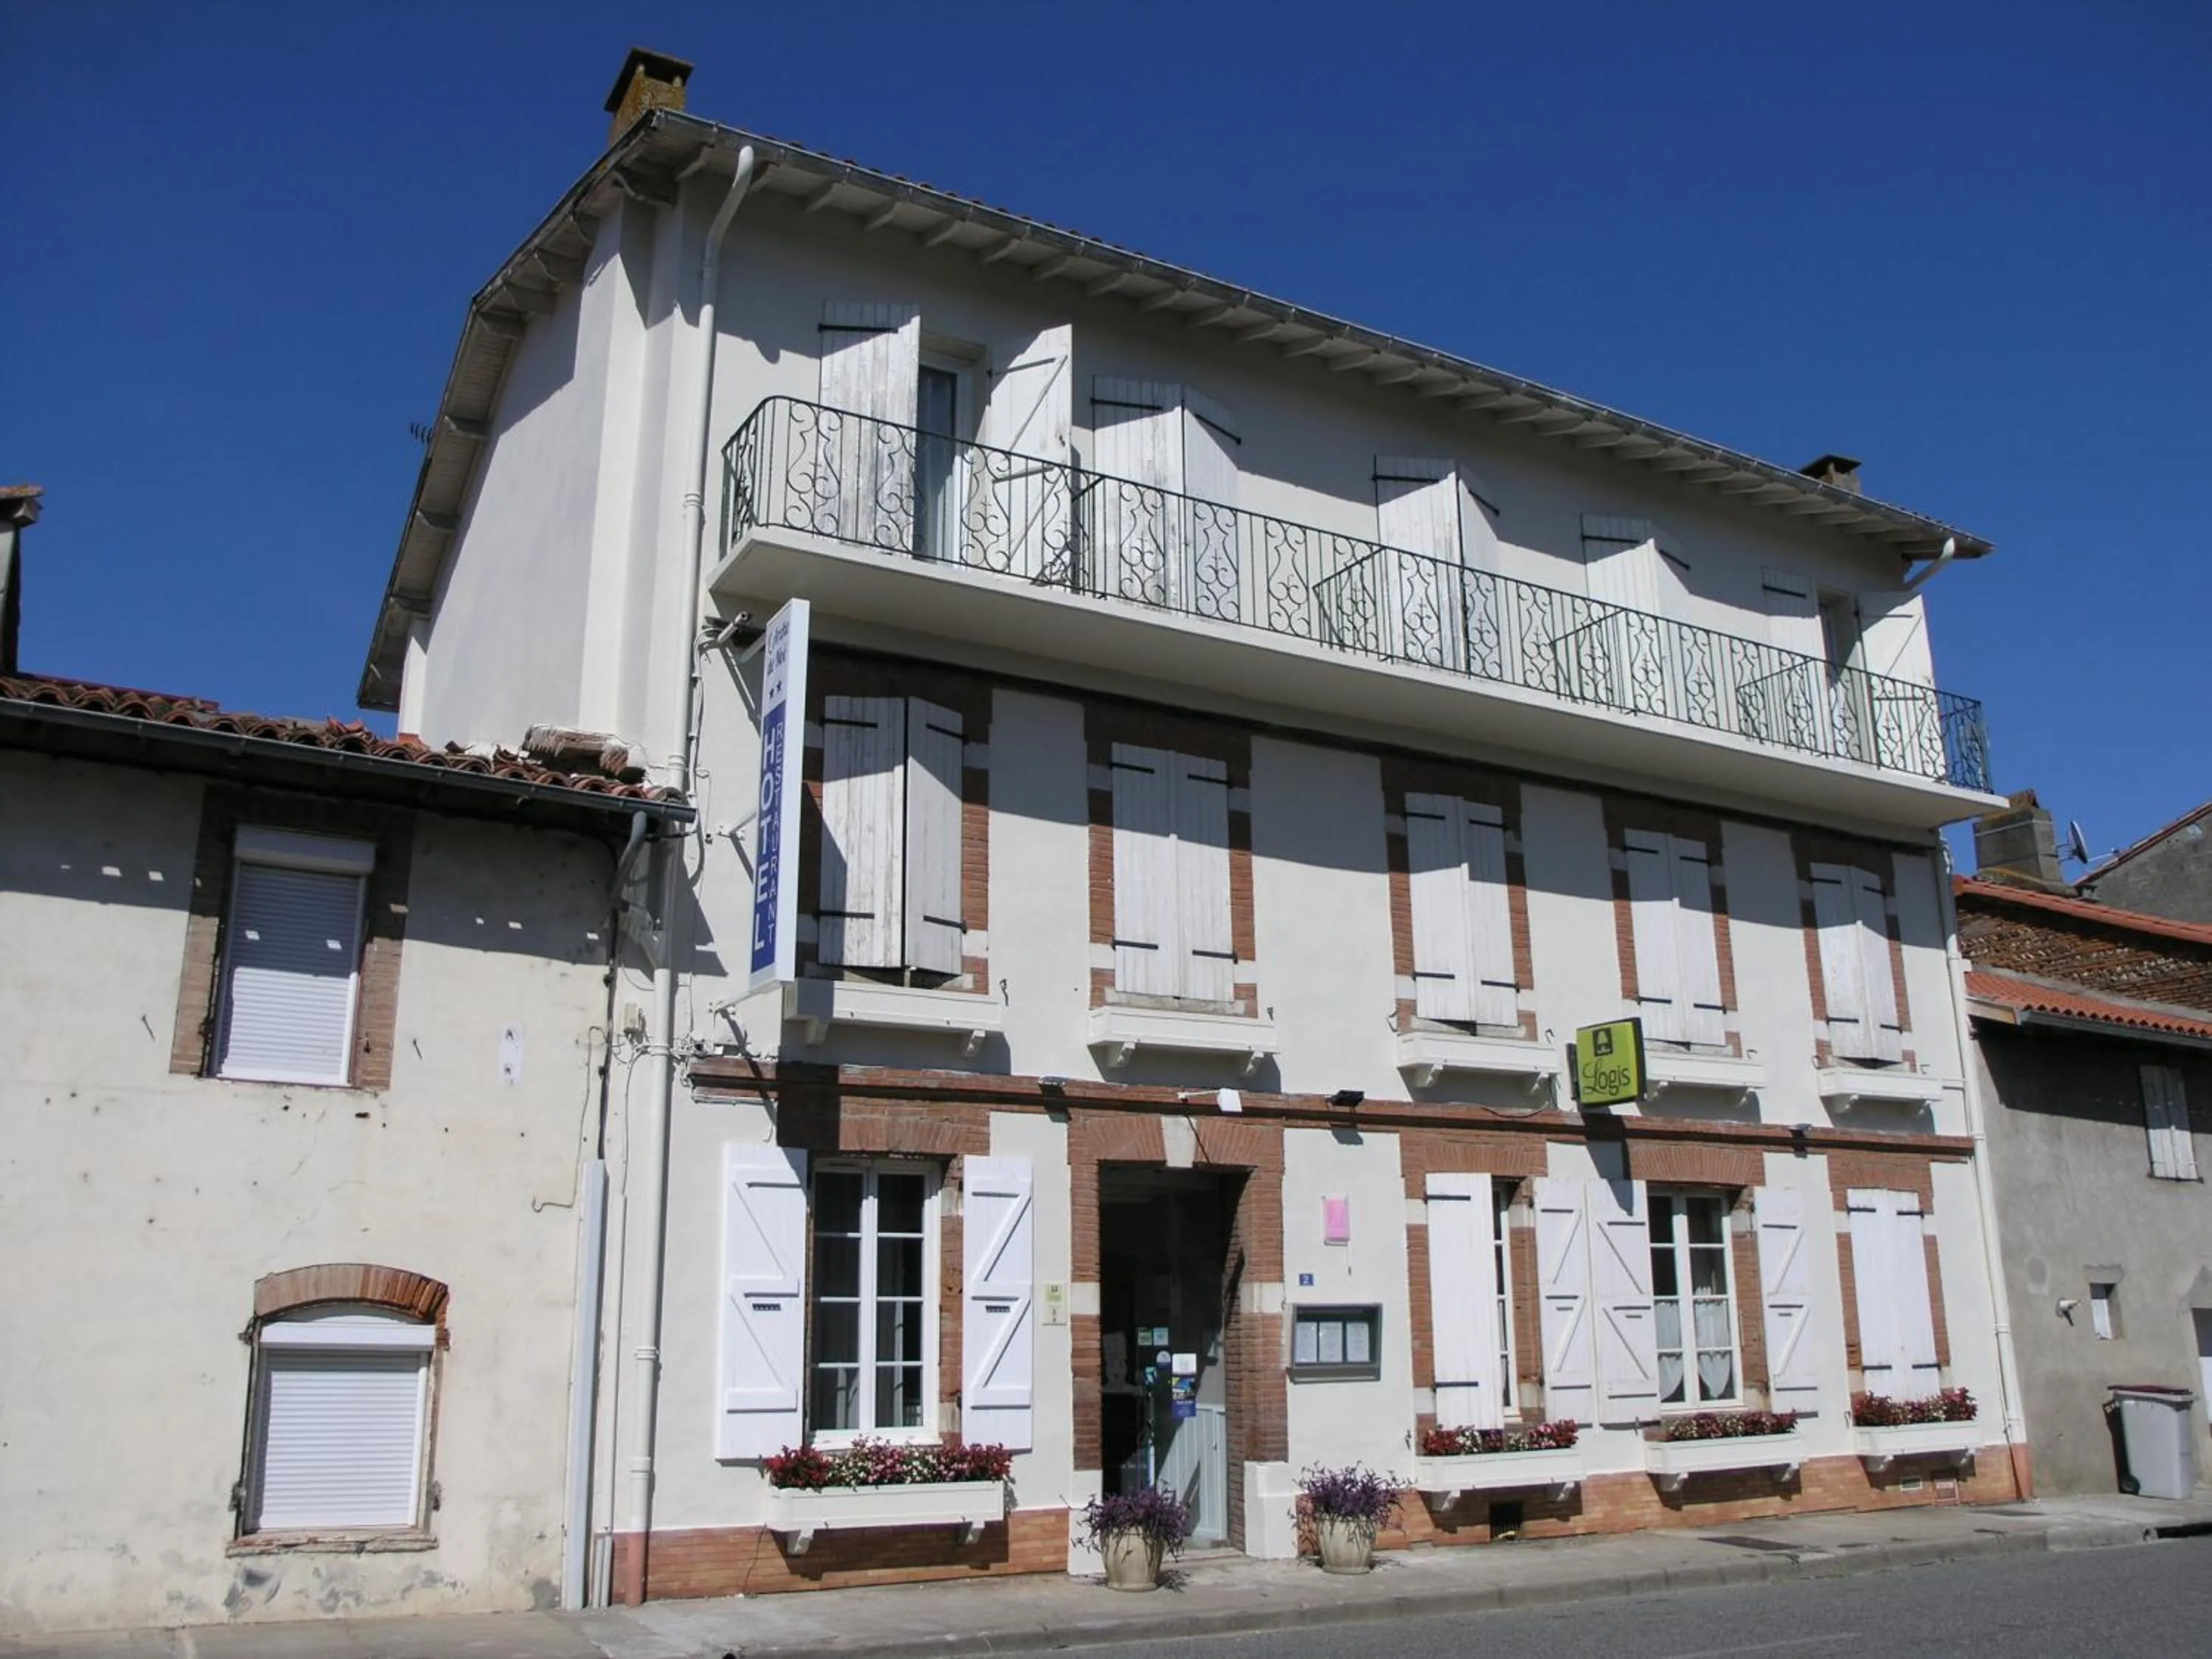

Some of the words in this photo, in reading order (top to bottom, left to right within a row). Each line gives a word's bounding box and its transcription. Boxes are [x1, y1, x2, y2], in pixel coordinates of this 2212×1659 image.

[754, 726, 776, 951] HOTEL
[768, 722, 784, 945] RESTAURANT
[1582, 1059, 1630, 1096] Logis
